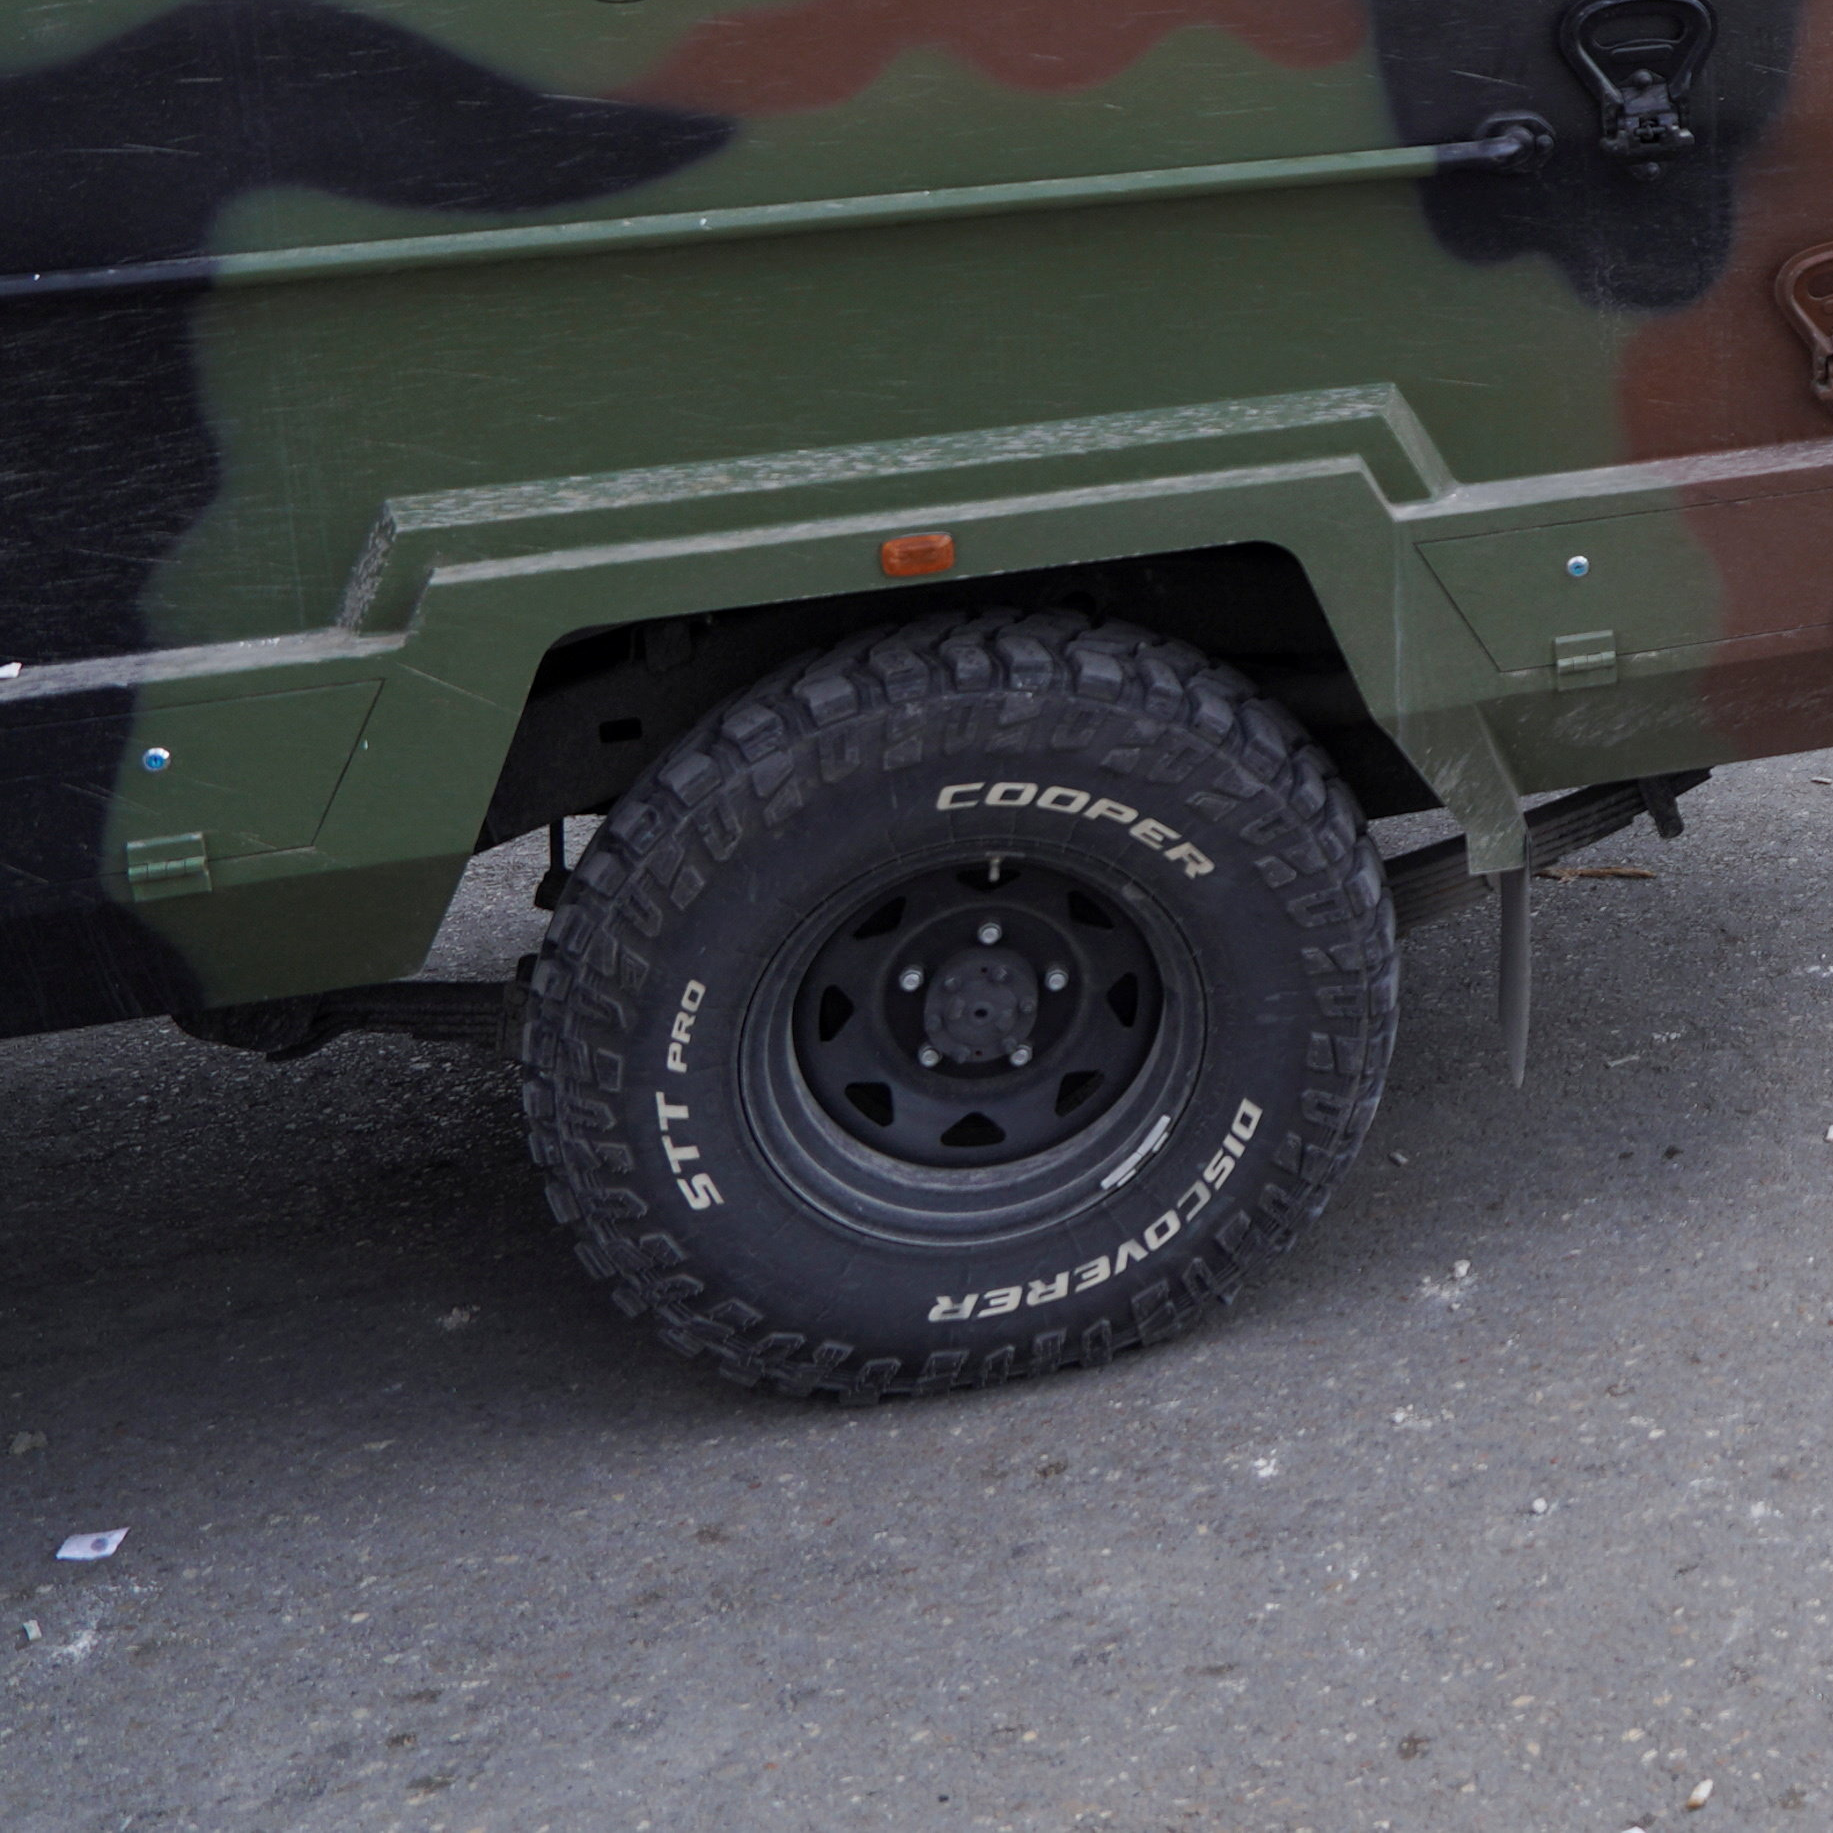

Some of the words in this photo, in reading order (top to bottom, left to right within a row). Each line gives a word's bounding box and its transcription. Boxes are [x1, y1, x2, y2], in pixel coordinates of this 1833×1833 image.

[934, 780, 1215, 880] COOPER
[665, 979, 707, 1075] PRO
[655, 1090, 724, 1212] STT
[928, 1097, 1264, 1323] DISCOVERER
